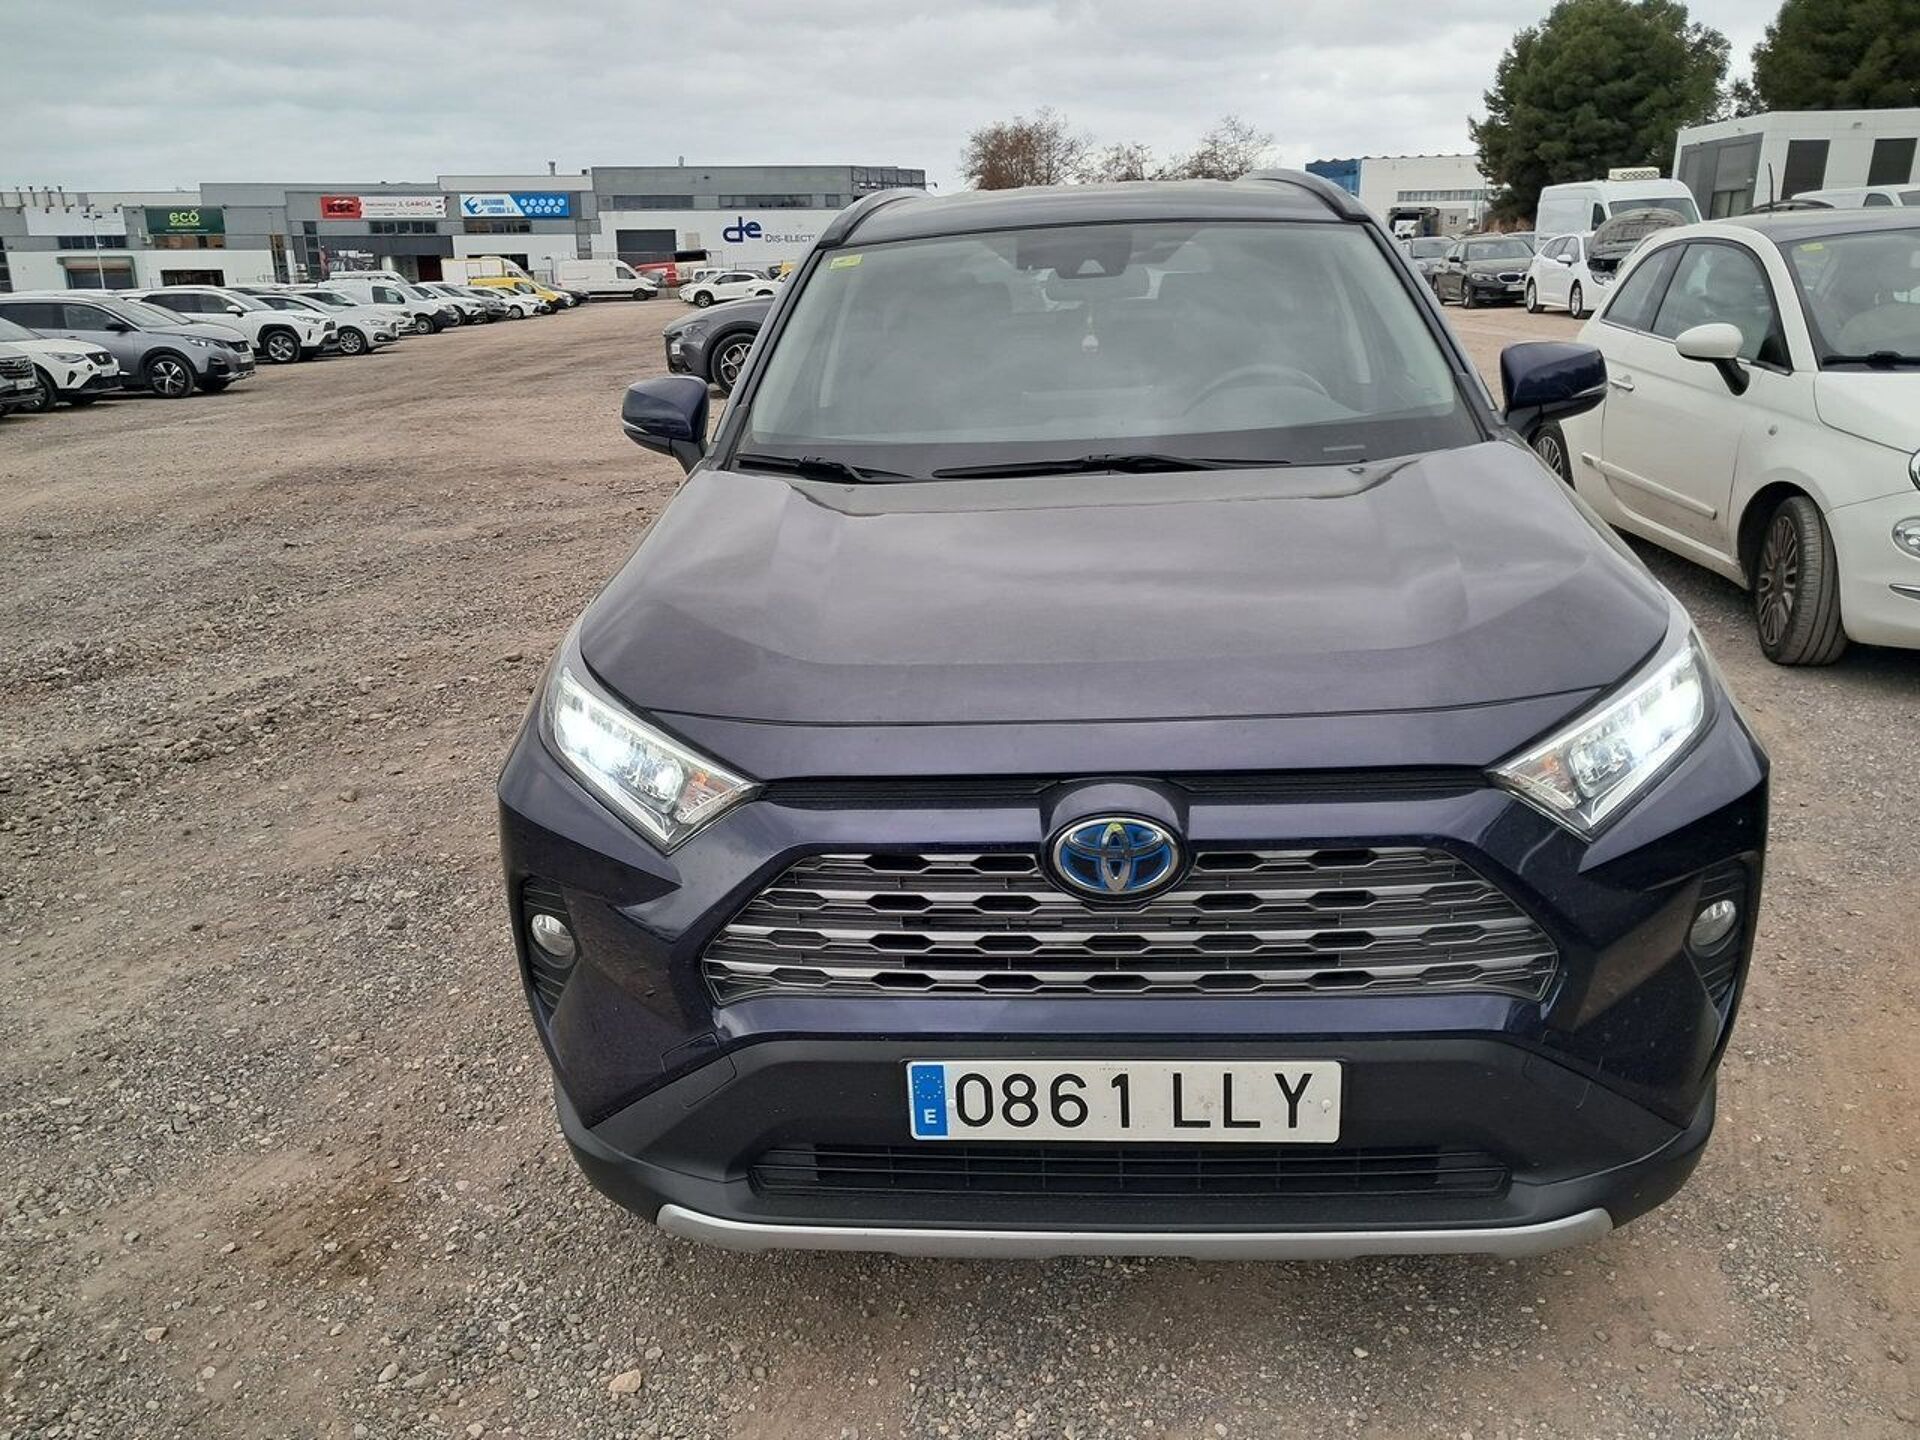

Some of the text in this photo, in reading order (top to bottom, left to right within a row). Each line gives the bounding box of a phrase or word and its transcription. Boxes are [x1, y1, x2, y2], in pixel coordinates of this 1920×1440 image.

[722, 216, 762, 243] de
[955, 1072, 1313, 1129] 0861 LLY
[924, 1109, 937, 1124] E
